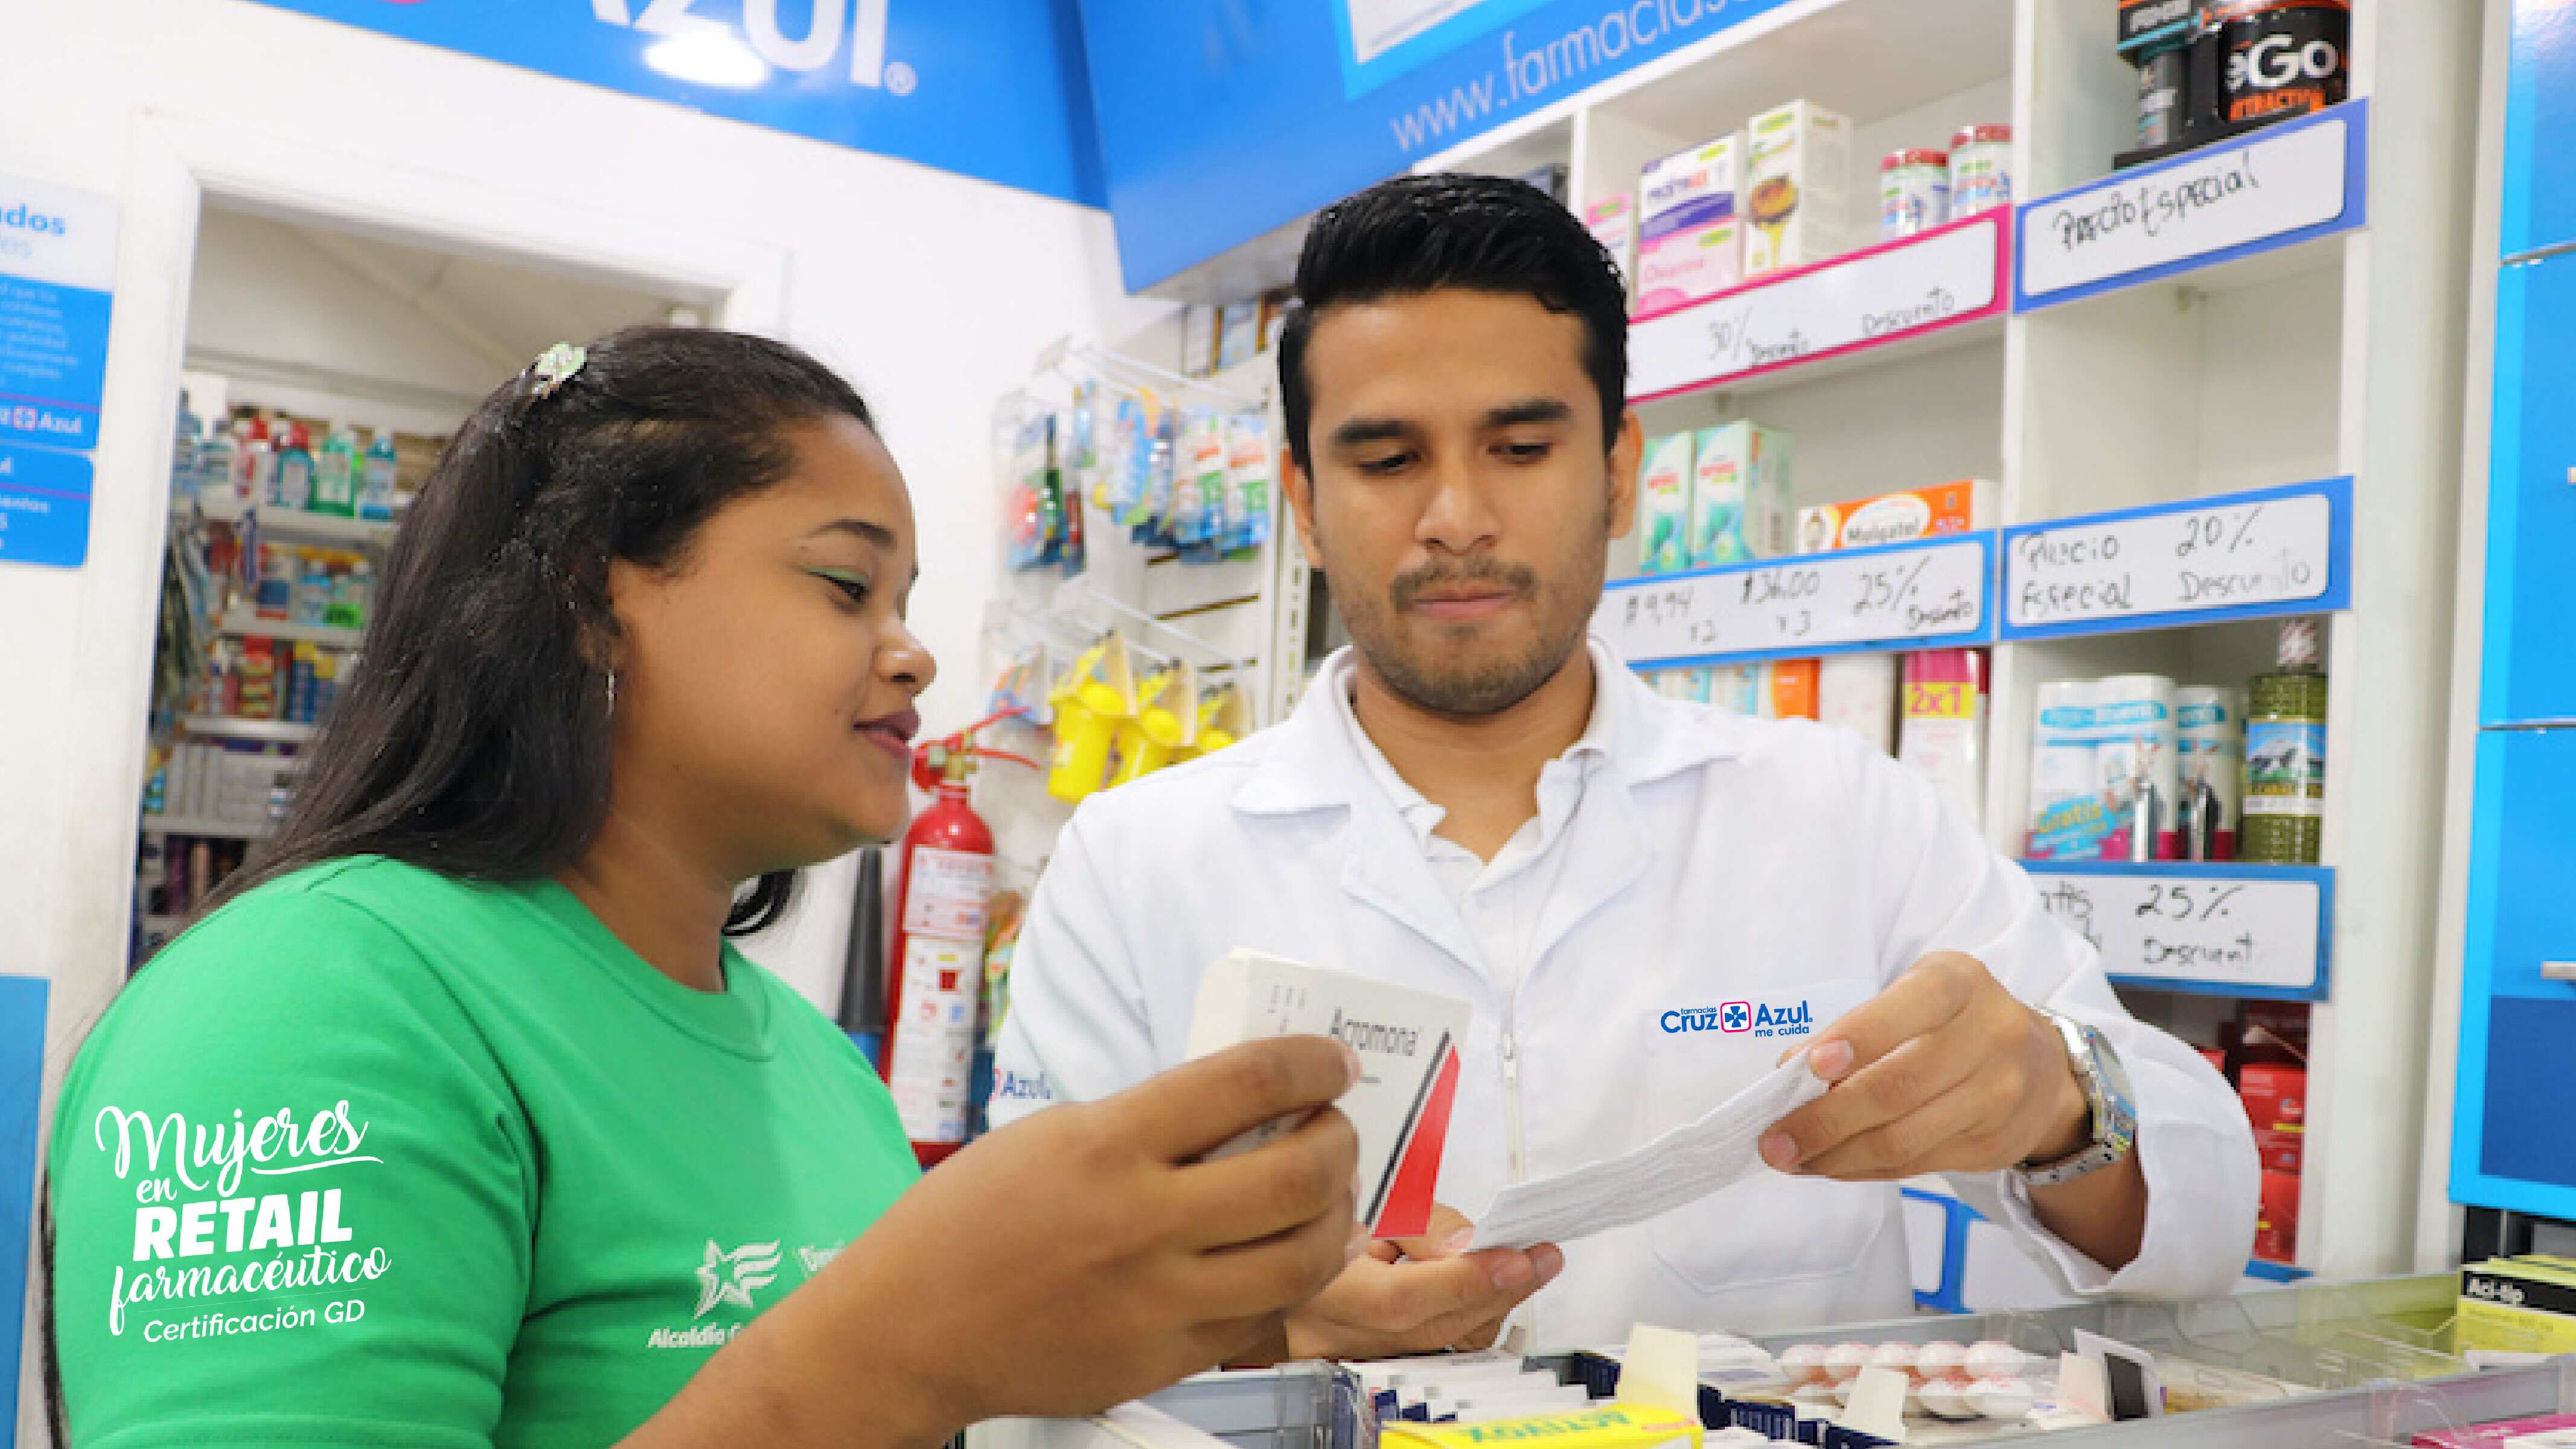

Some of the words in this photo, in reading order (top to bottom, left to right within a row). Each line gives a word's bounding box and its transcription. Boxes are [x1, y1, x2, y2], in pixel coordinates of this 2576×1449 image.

[1392, 0, 1726, 151] www.farmacia
[0, 204, 66, 236] dos
[2175, 504, 2264, 558] 20%
[2134, 883, 2246, 920] 25%
[1660, 1009, 1719, 1034] Cruz
[1680, 1005, 1718, 1016] farmacias
[1754, 1028, 1773, 1038] me
[1778, 1024, 1810, 1036] cuida
[95, 1099, 369, 1198] Mujeres
[136, 1178, 177, 1204] en
[132, 1188, 353, 1262] RETAIL
[109, 1245, 392, 1336] farmacéutico
[143, 1305, 316, 1343] Certificación
[324, 1299, 366, 1325] GD
